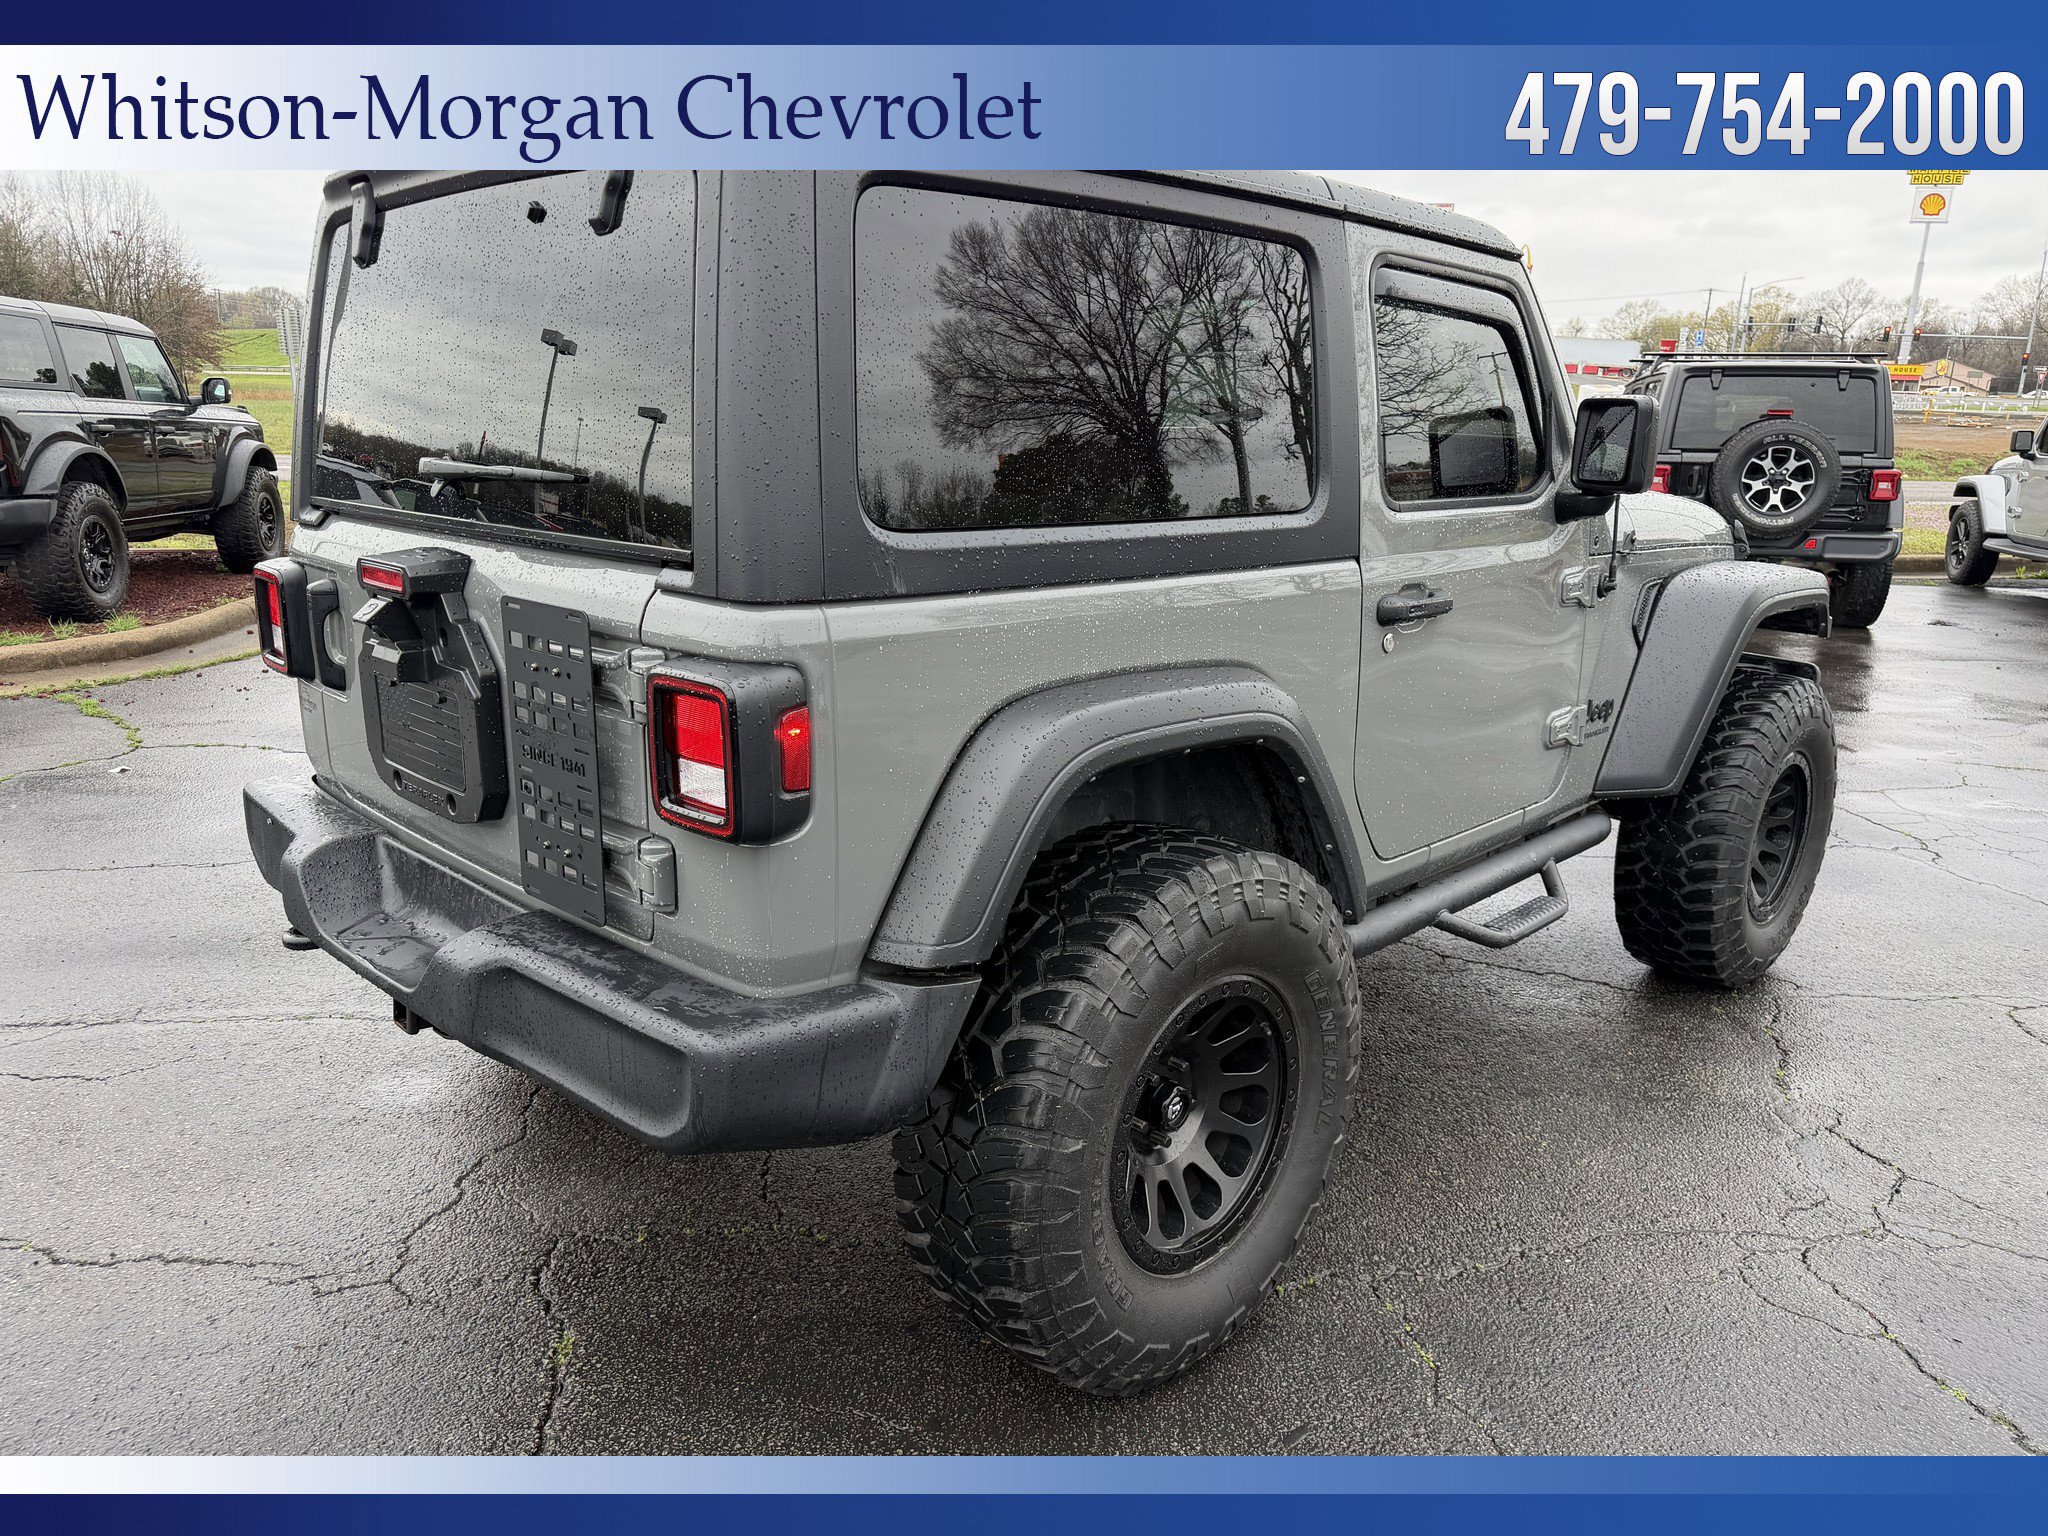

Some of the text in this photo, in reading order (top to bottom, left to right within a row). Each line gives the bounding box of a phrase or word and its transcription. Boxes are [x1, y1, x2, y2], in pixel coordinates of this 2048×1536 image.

[1913, 175, 1963, 183] HOUSE
[560, 756, 586, 778] 1941
[1304, 969, 1339, 1134] GENERAL
